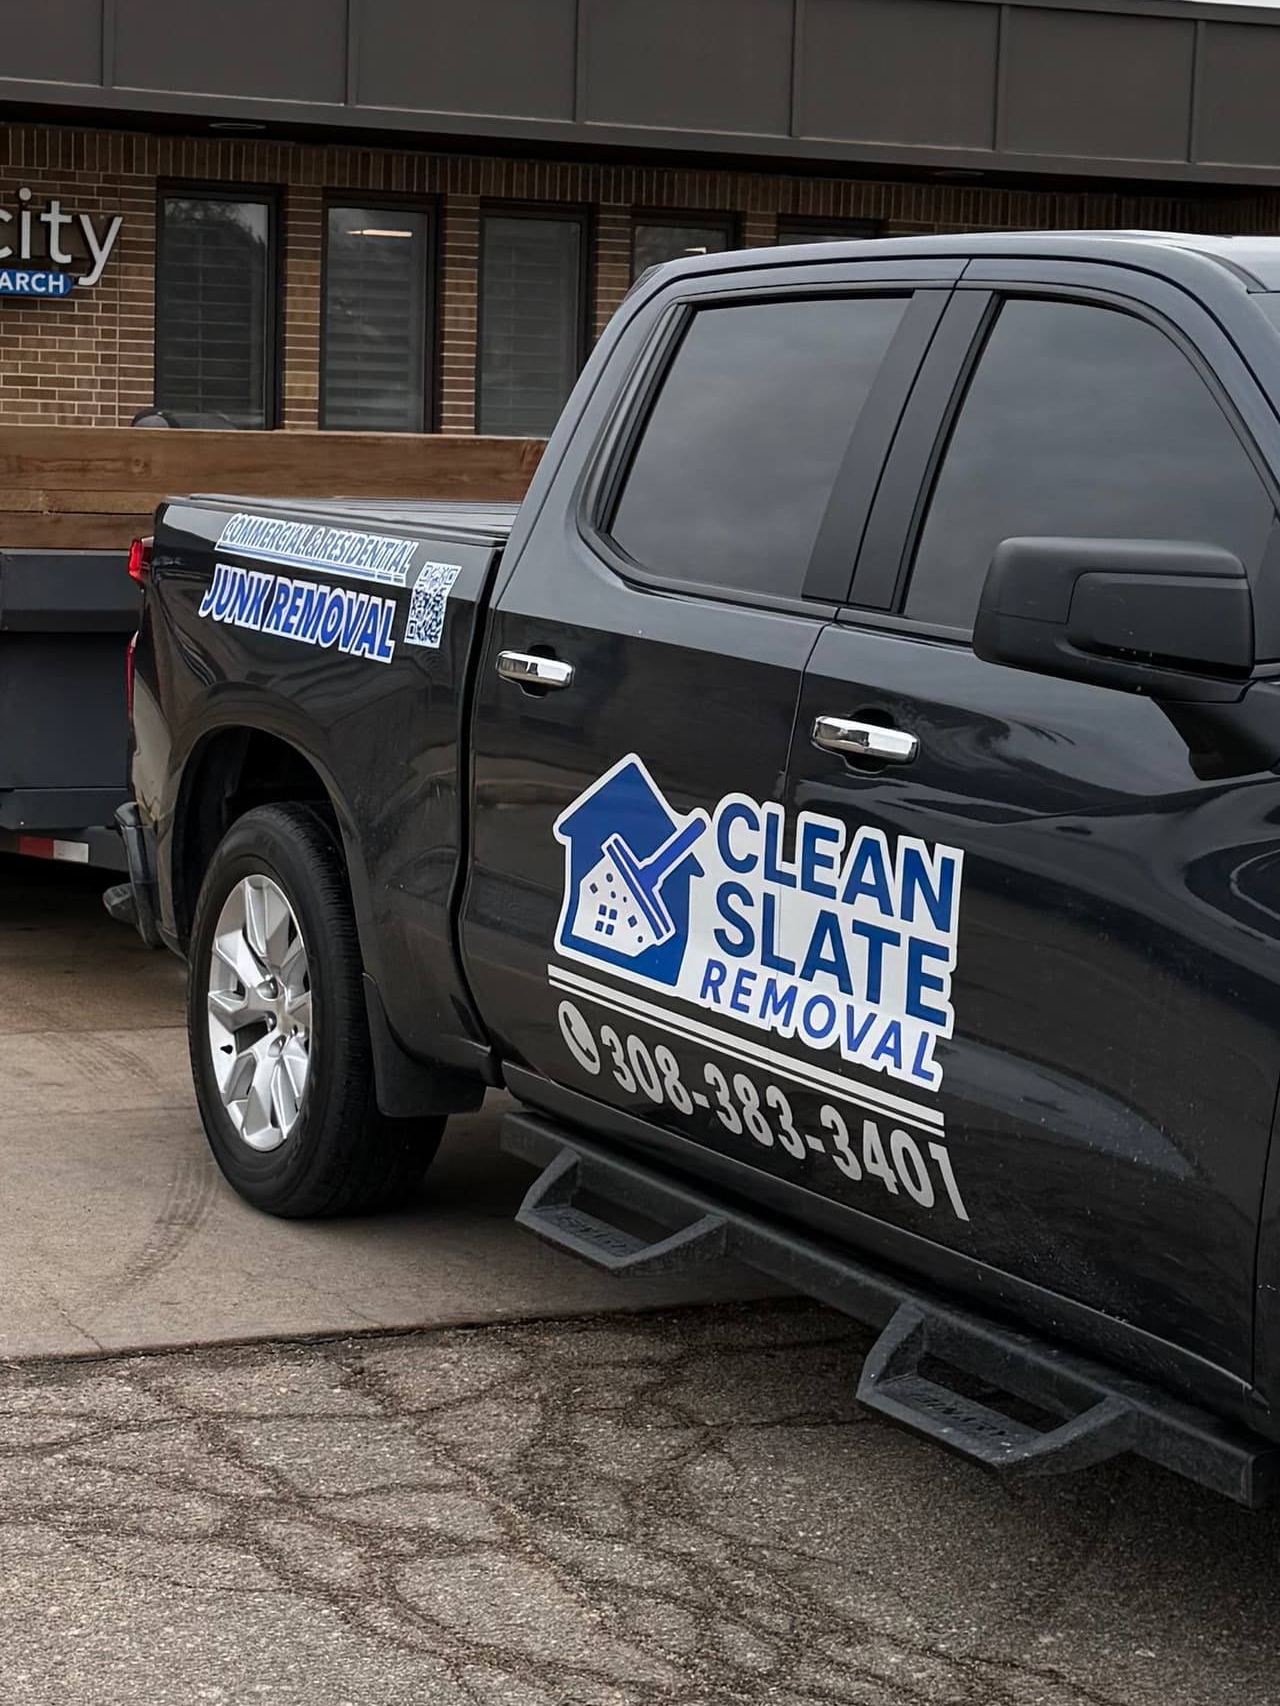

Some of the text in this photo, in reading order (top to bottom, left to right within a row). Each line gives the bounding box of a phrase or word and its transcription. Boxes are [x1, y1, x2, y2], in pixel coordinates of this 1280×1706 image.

[221, 515, 312, 557] COMMERCIAL
[322, 530, 417, 574] RESIDENTIAL
[201, 566, 396, 659] JUNK REMOVAL
[716, 801, 956, 934] CLEAN
[713, 881, 950, 1027] SLATE
[699, 959, 936, 1083] REMOVAL
[600, 1024, 970, 1222] 308-383-3401
